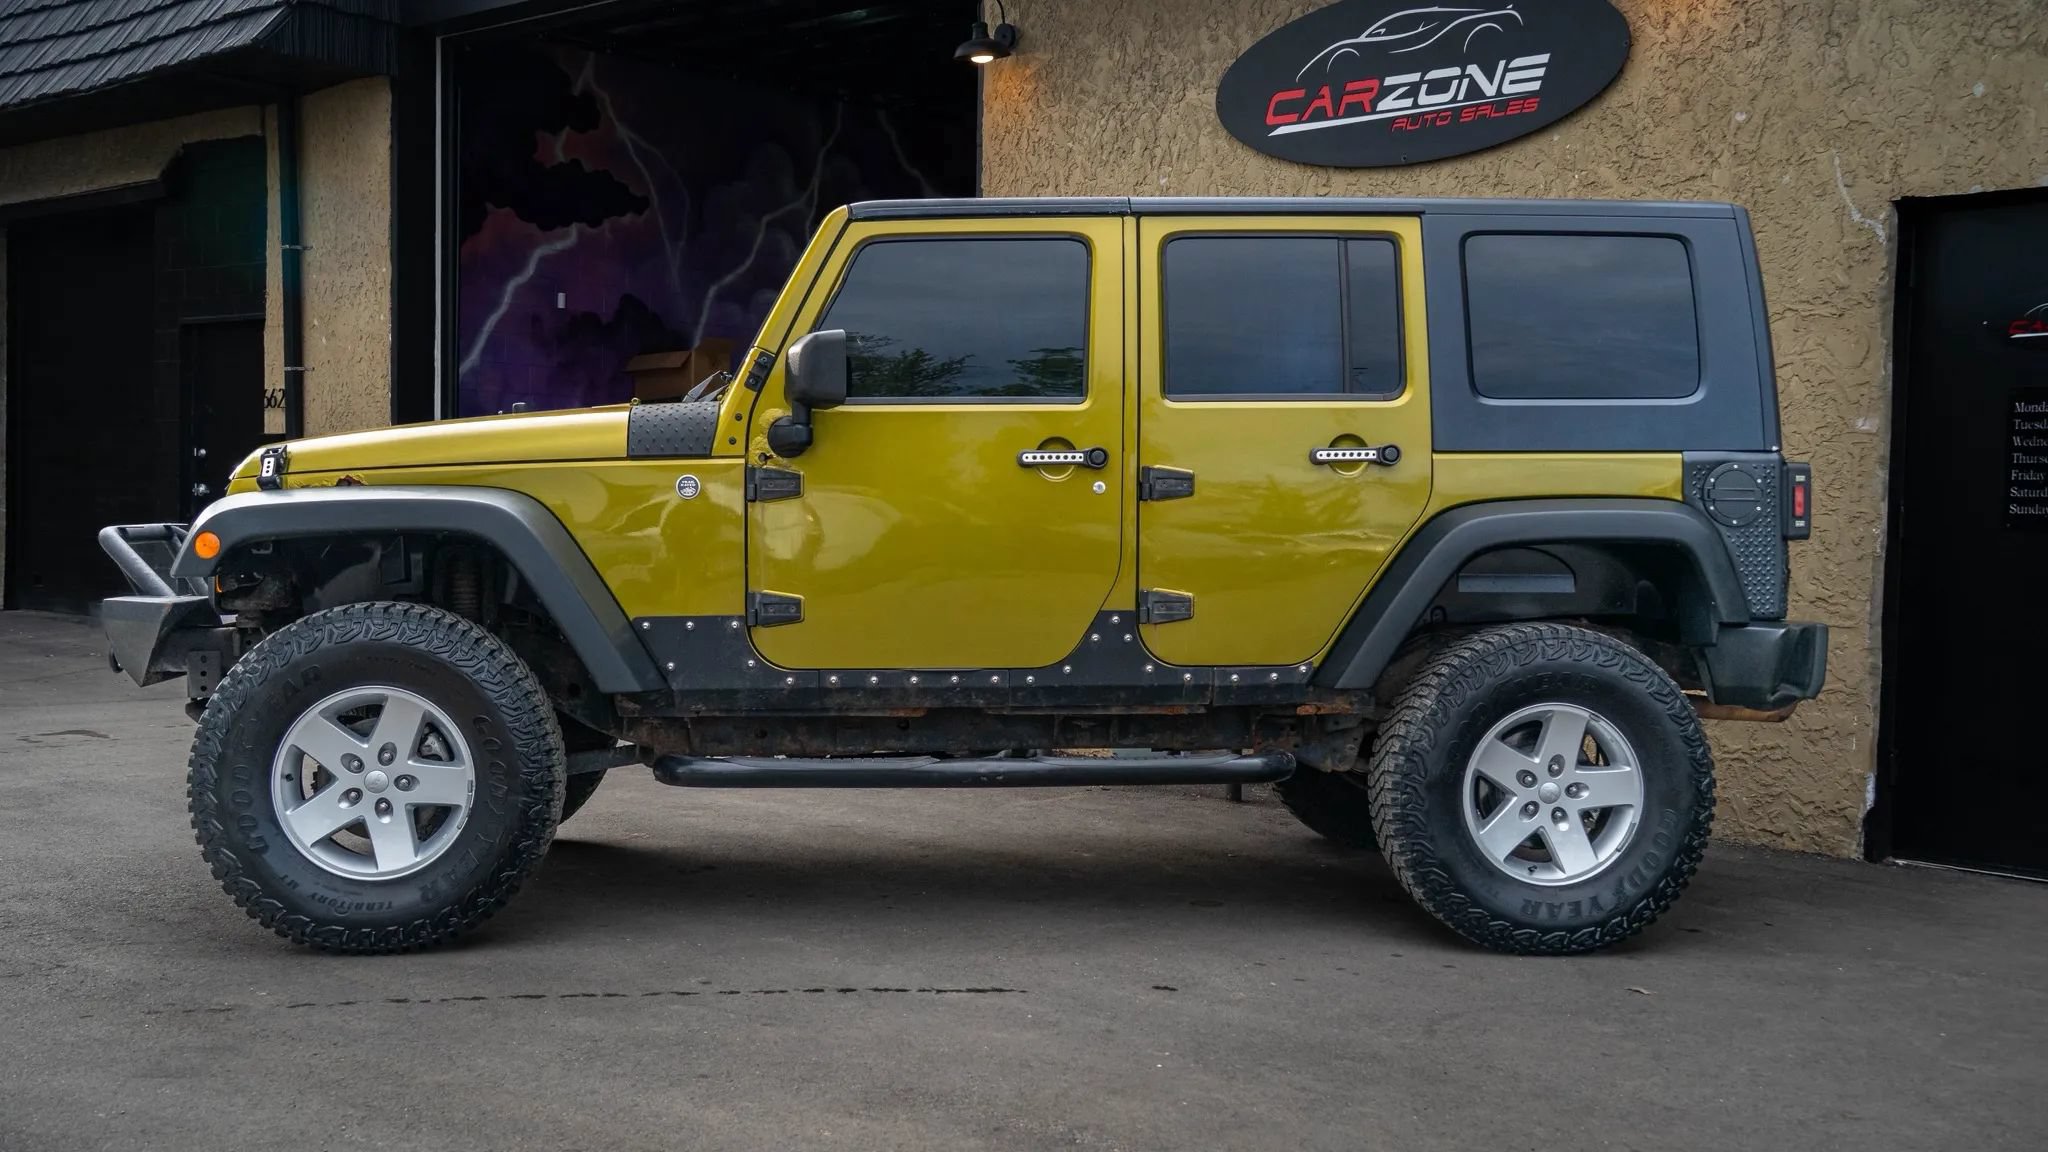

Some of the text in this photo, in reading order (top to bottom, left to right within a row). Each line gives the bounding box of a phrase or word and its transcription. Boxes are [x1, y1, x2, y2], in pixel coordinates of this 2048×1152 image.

[1264, 53, 1551, 127] CARZONE
[1391, 96, 1542, 134] AUTO SALES
[2013, 418, 2048, 430] Tuesd
[2011, 469, 2047, 484] Friday
